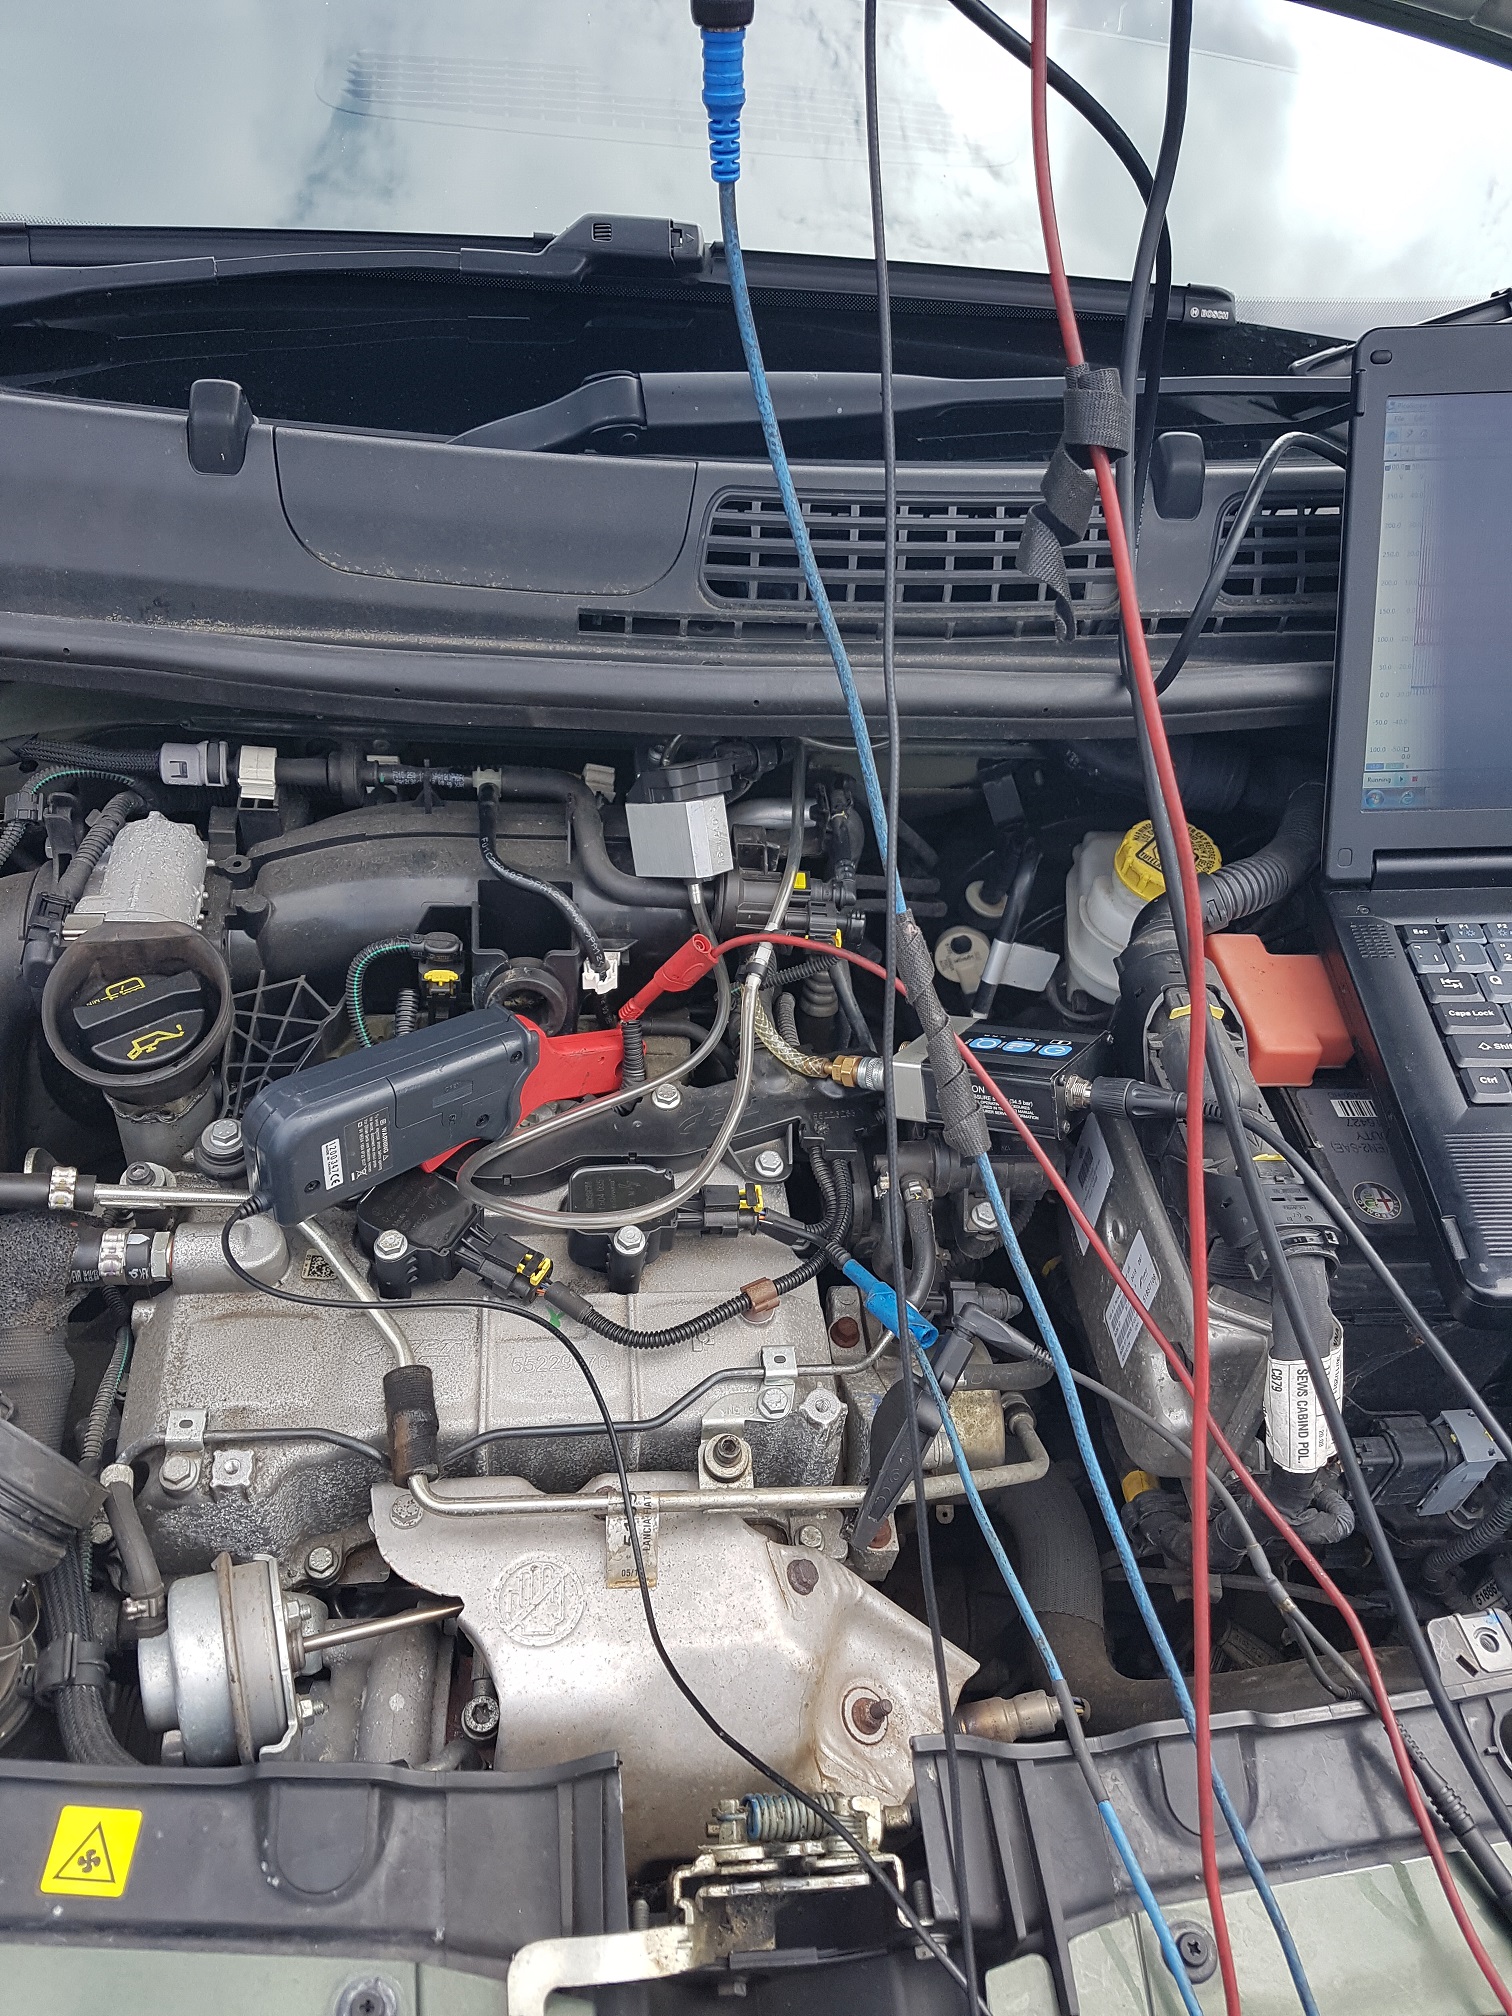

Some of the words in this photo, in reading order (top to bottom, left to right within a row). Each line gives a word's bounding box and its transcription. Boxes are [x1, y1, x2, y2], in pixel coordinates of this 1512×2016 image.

[1201, 309, 1229, 320] BOSCH
[1367, 776, 1392, 784] Running
[1412, 928, 1429, 936] Esc
[1489, 975, 1503, 985] Q
[1448, 1010, 1471, 1018] Caps
[1472, 1009, 1495, 1017] Lock
[1479, 1076, 1499, 1084] Ctrl
[511, 1354, 610, 1374] 5522970
[1271, 1368, 1283, 1393] C879
[1296, 1368, 1309, 1397] SEWS
[1296, 1400, 1309, 1439] CABIND
[1297, 1442, 1310, 1464] POL.
[621, 1568, 638, 1578] 05/1
